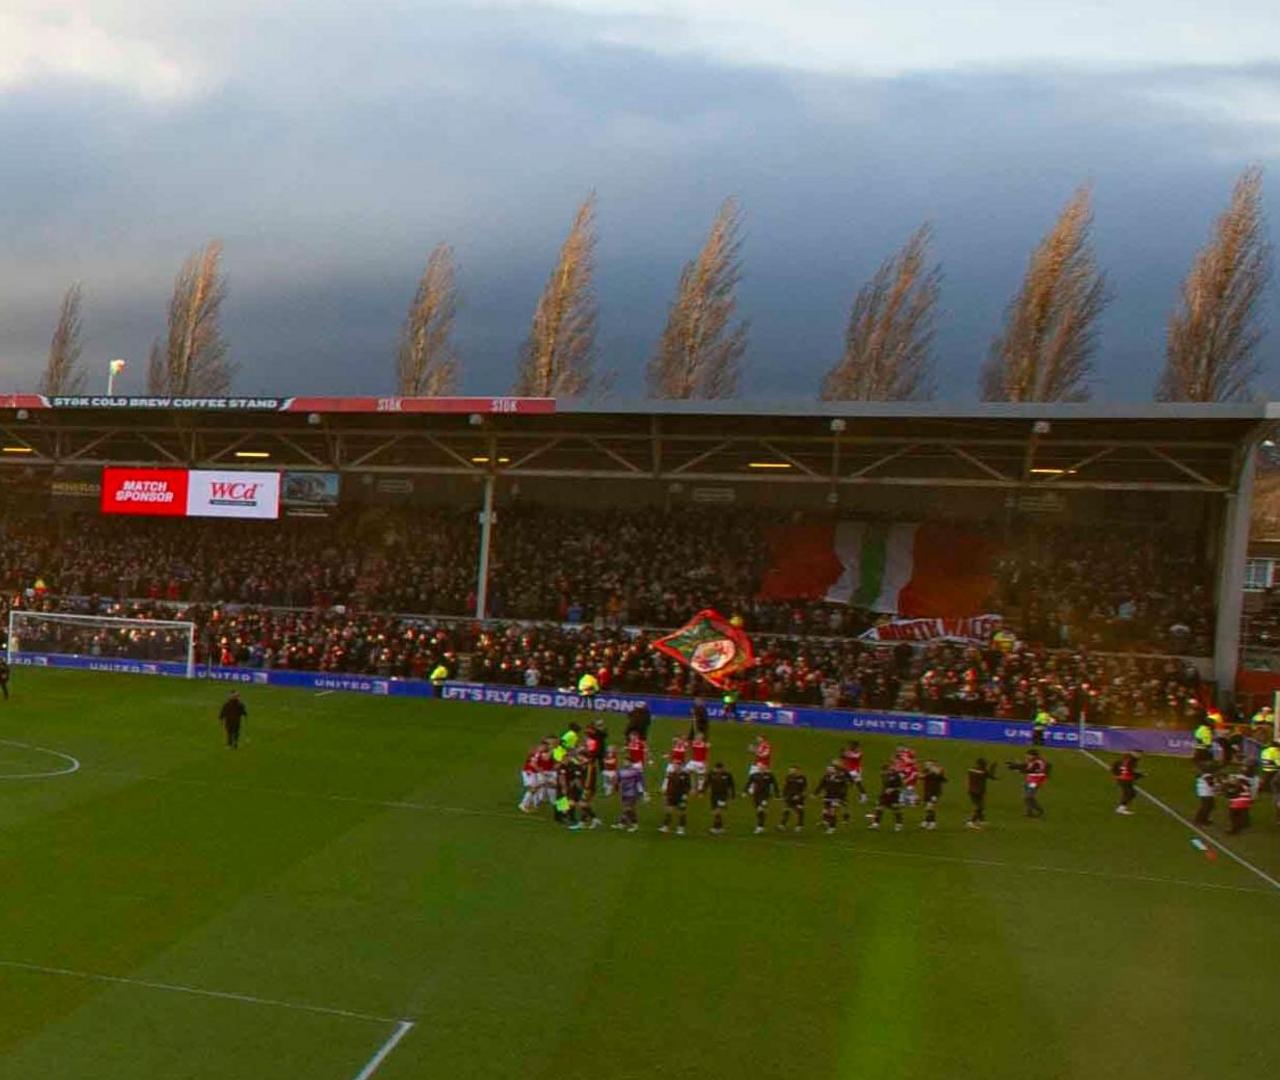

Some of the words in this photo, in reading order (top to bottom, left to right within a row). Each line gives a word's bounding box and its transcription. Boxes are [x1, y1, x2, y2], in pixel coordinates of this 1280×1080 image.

[91, 398, 126, 407] COLD
[130, 398, 171, 408] BREW
[173, 399, 227, 408] COFFEE
[229, 399, 277, 409] STAND
[123, 480, 167, 492] MATCH
[209, 481, 257, 499] WCd
[115, 490, 173, 503] SPONSOR
[314, 678, 371, 691] UNITED
[442, 686, 483, 700] LET'S
[485, 688, 513, 706] FLY,
[517, 691, 553, 706] RED
[707, 707, 773, 721] UTED
[852, 717, 924, 732] UNITED
[1003, 728, 1079, 742] UNTED
